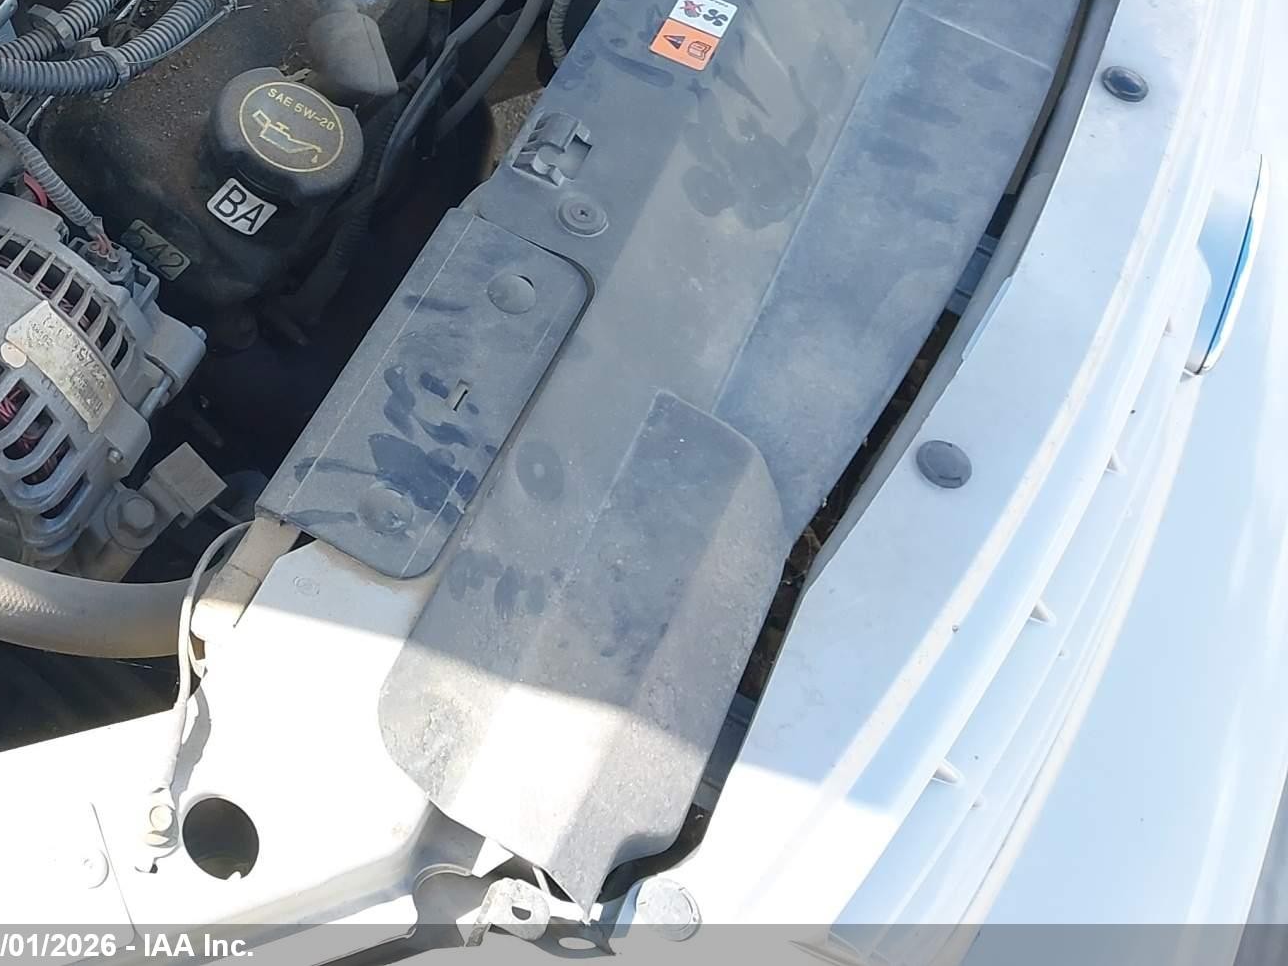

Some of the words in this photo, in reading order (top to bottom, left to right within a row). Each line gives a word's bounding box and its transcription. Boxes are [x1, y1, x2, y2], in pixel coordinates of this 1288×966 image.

[267, 87, 294, 109] SAE
[294, 102, 336, 132] 5W-20
[213, 185, 266, 232] BA
[127, 225, 184, 273] 542
